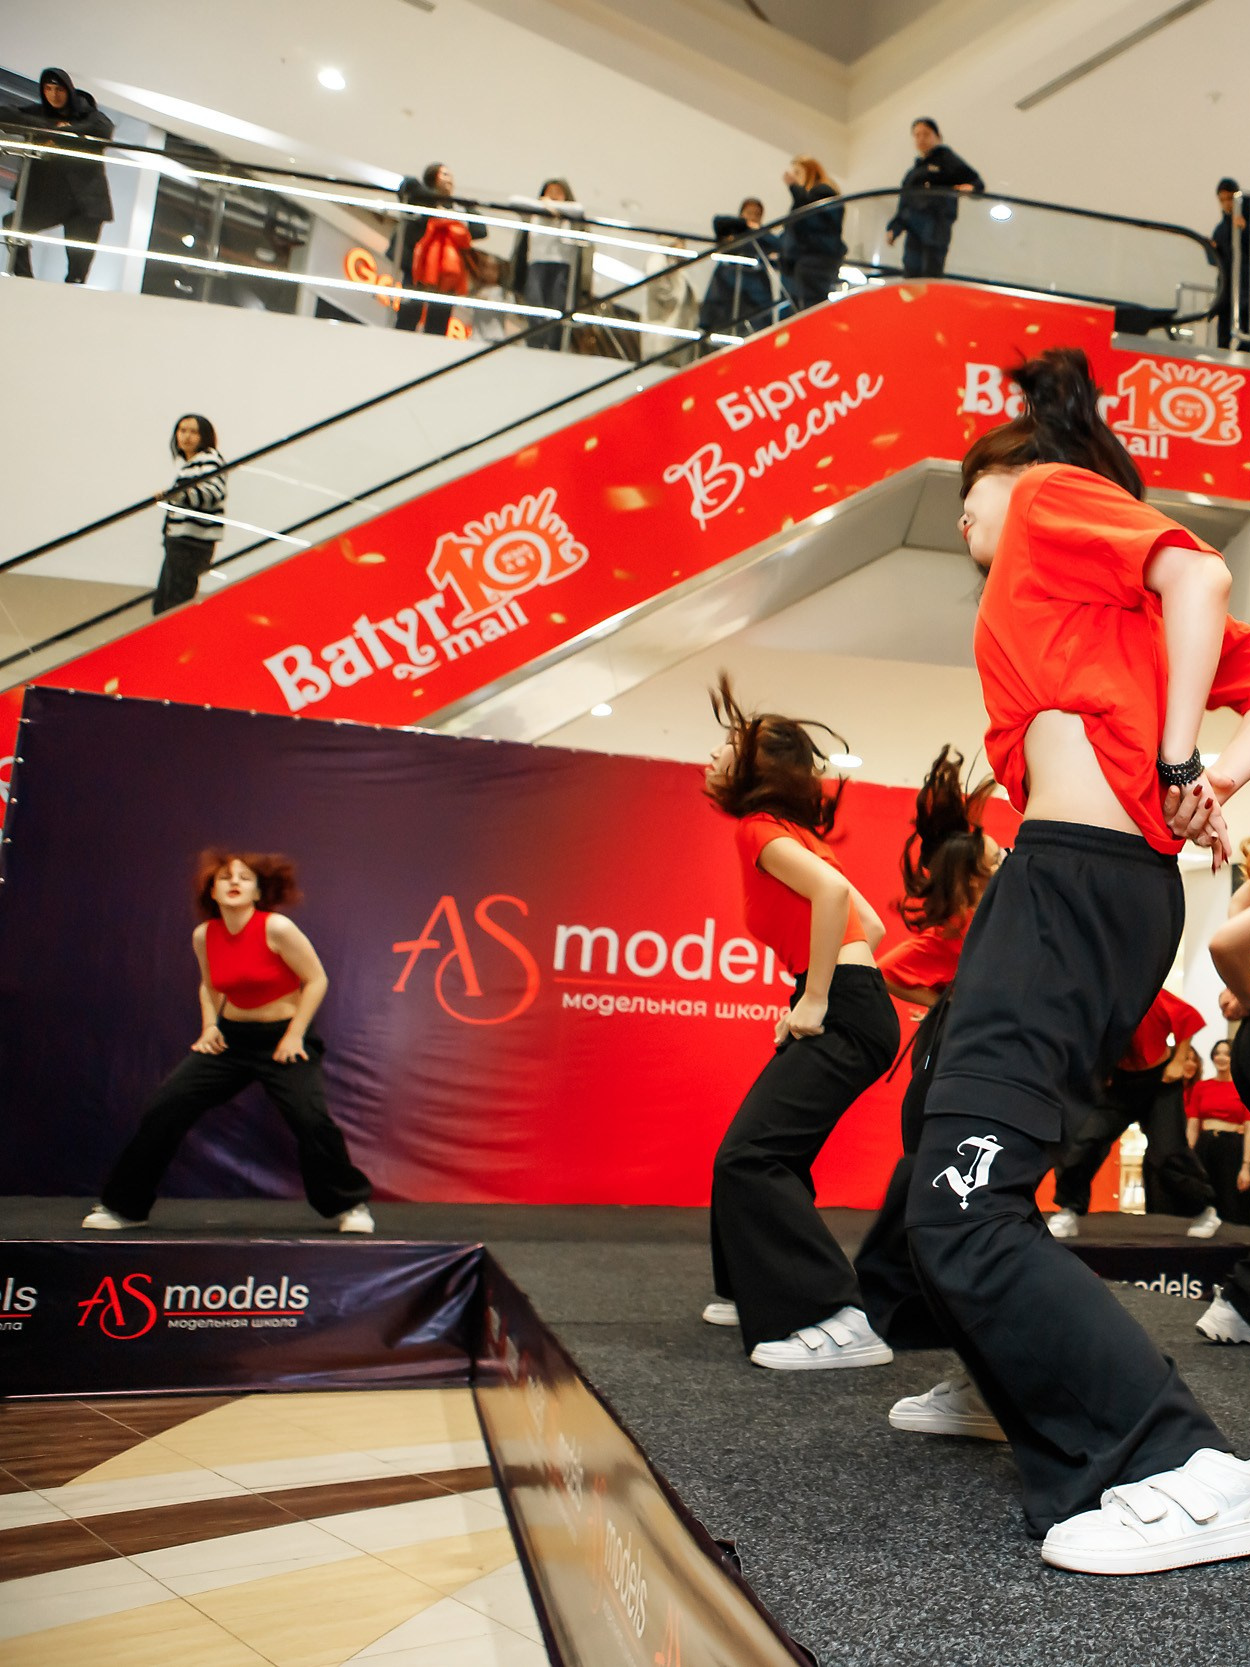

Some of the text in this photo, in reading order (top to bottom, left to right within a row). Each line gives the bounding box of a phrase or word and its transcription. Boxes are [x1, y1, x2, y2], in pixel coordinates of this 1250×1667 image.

[716, 360, 840, 432] Бірге
[663, 372, 884, 532] Вместе
[1121, 433, 1169, 459] all
[263, 591, 450, 712] Batyr
[438, 599, 530, 661] mall
[392, 893, 541, 1025] AS
[561, 991, 707, 1017] модельная
[78, 1273, 157, 1340] AS
[164, 1275, 310, 1310] models
[251, 1317, 298, 1329] школа
[604, 1518, 648, 1639] models
